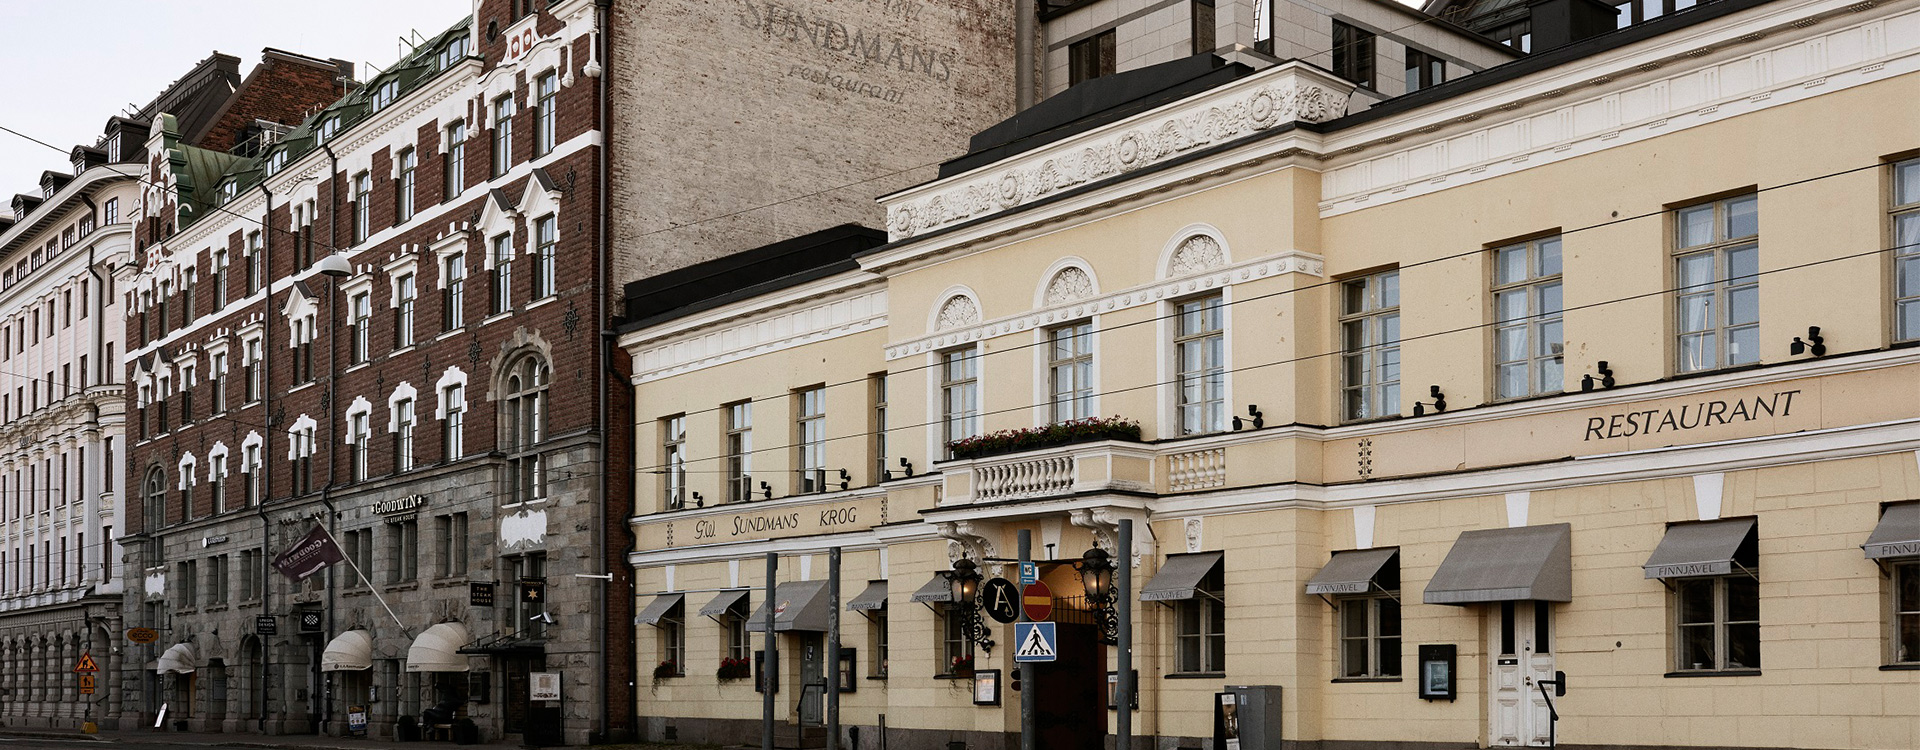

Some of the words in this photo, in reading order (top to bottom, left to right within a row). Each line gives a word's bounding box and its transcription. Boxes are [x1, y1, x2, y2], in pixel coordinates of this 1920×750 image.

[738, 0, 955, 82] SUNDMANS
[787, 64, 908, 105] restaurant
[1584, 389, 1801, 442] RESTAURANT
[375, 494, 417, 514] GOODWIN
[731, 515, 800, 536] SUNDMANS
[819, 506, 857, 527] KROG
[914, 594, 948, 602] RESTAURANT
